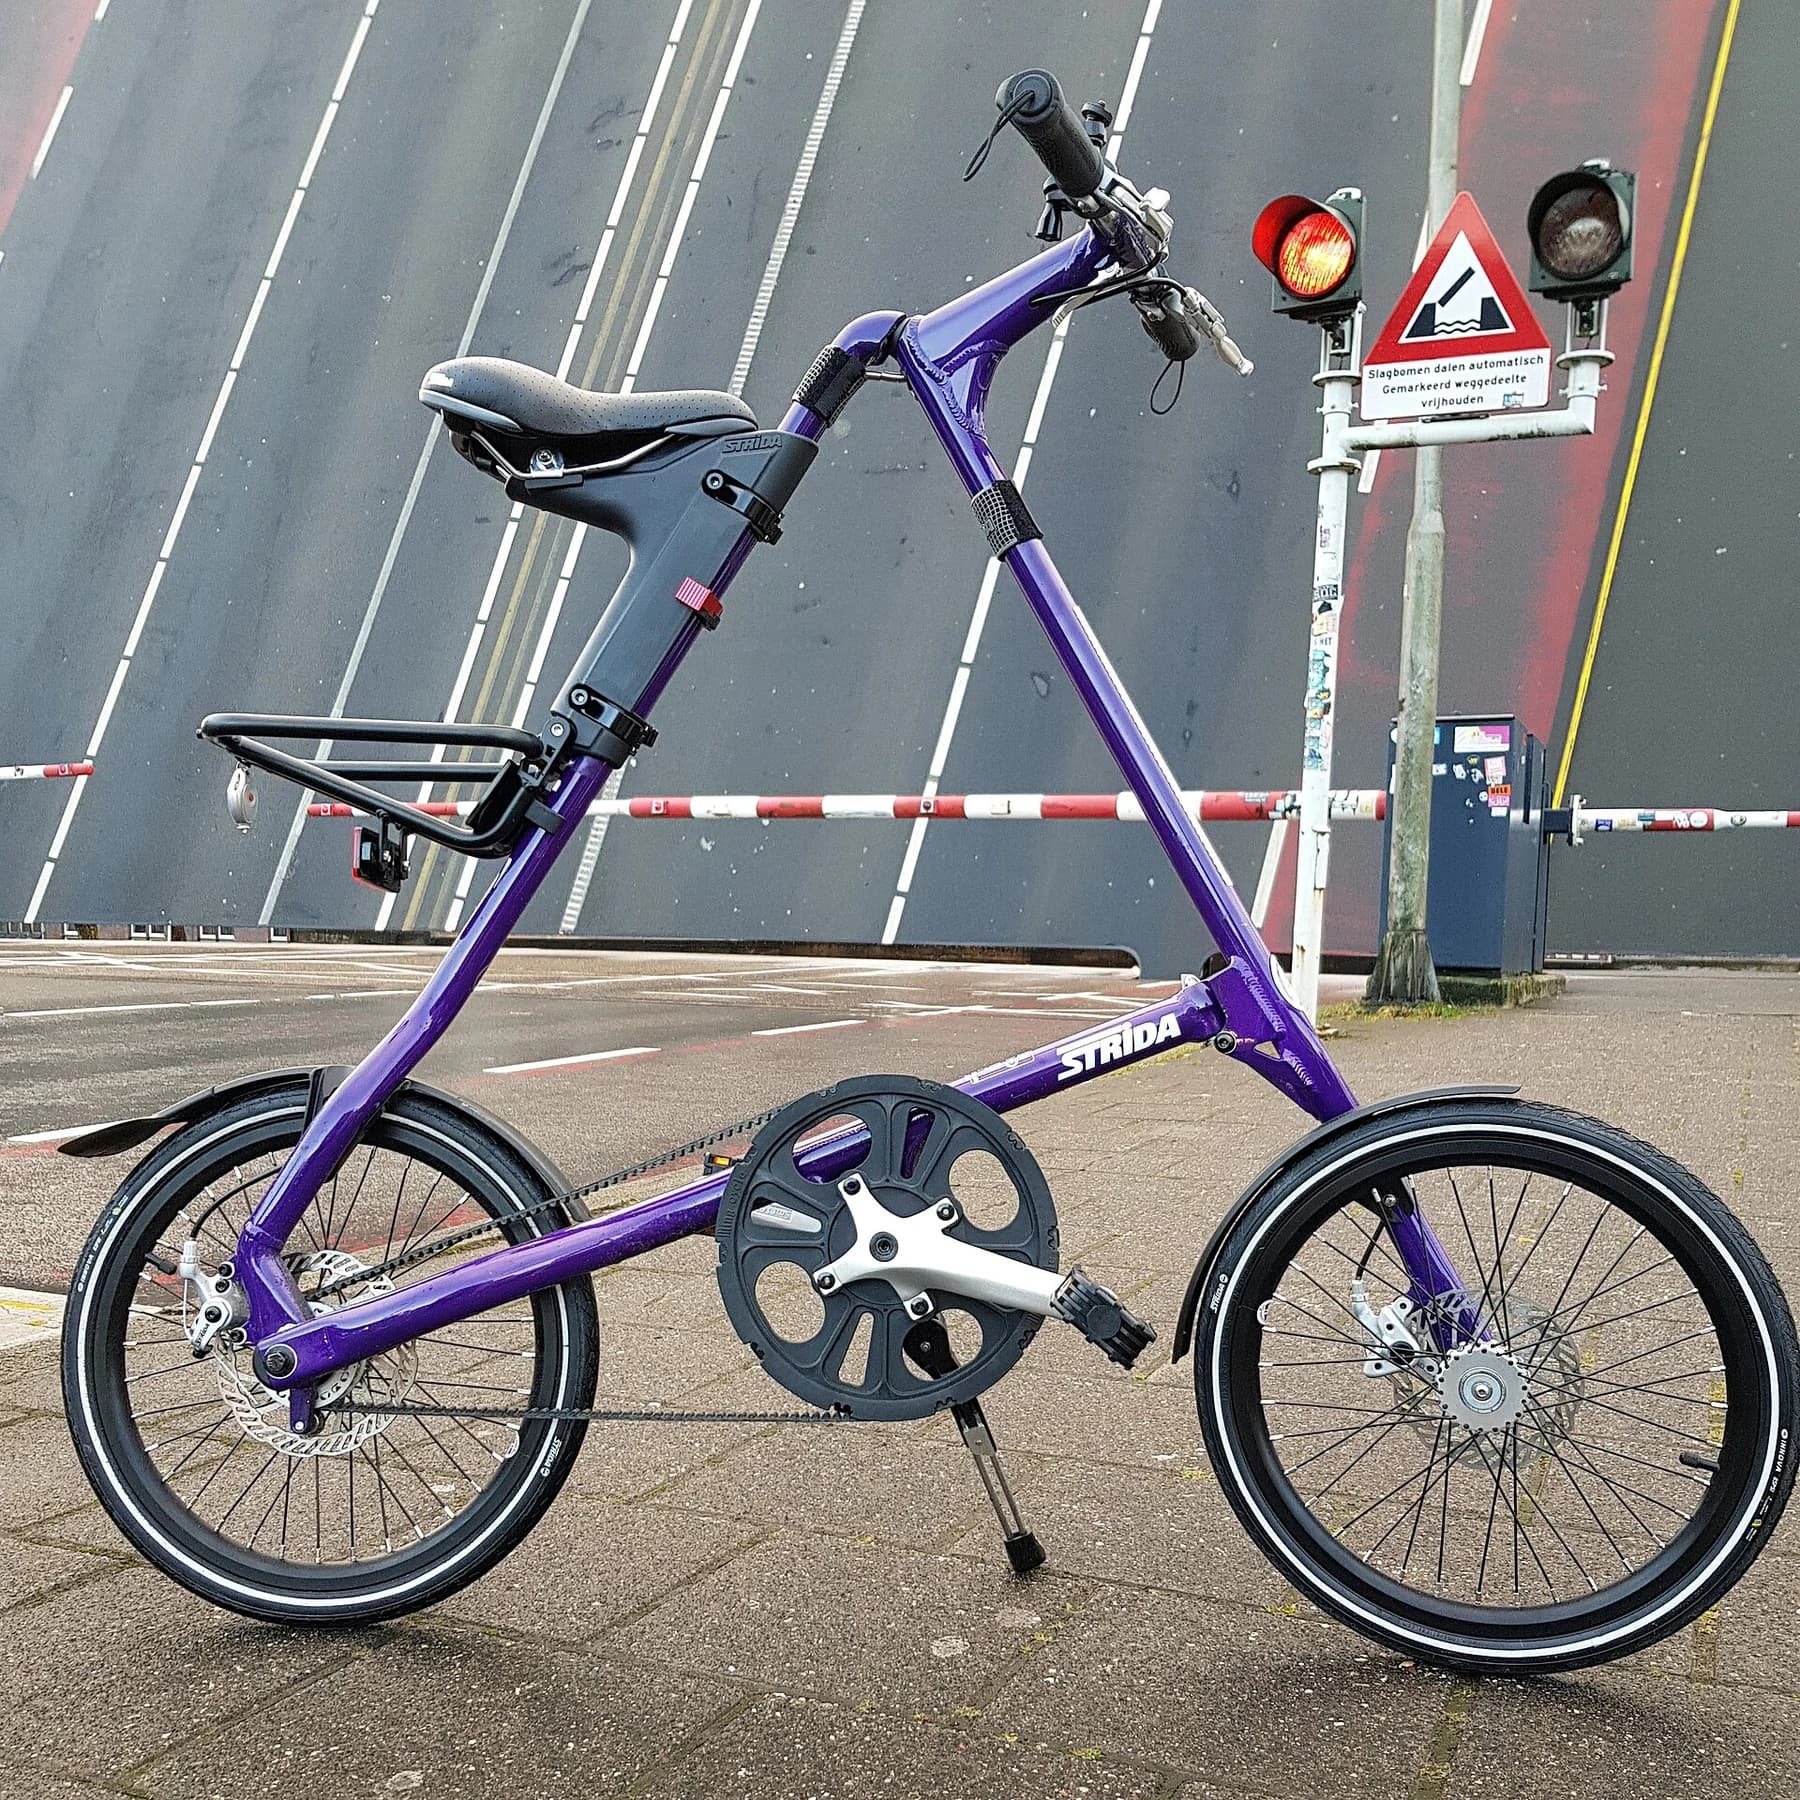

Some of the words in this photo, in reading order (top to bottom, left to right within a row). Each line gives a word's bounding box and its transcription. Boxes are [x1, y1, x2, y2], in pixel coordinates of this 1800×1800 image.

[1368, 366, 1431, 380] Slagbomen
[1434, 362, 1466, 374] dalen
[1469, 355, 1544, 371] automatisch
[1382, 379, 1451, 395] Gemarkeerd
[1455, 373, 1527, 390] weggedeelte
[1421, 394, 1484, 410] vrijhouden
[1775, 1439, 1787, 1473] INNOVA
